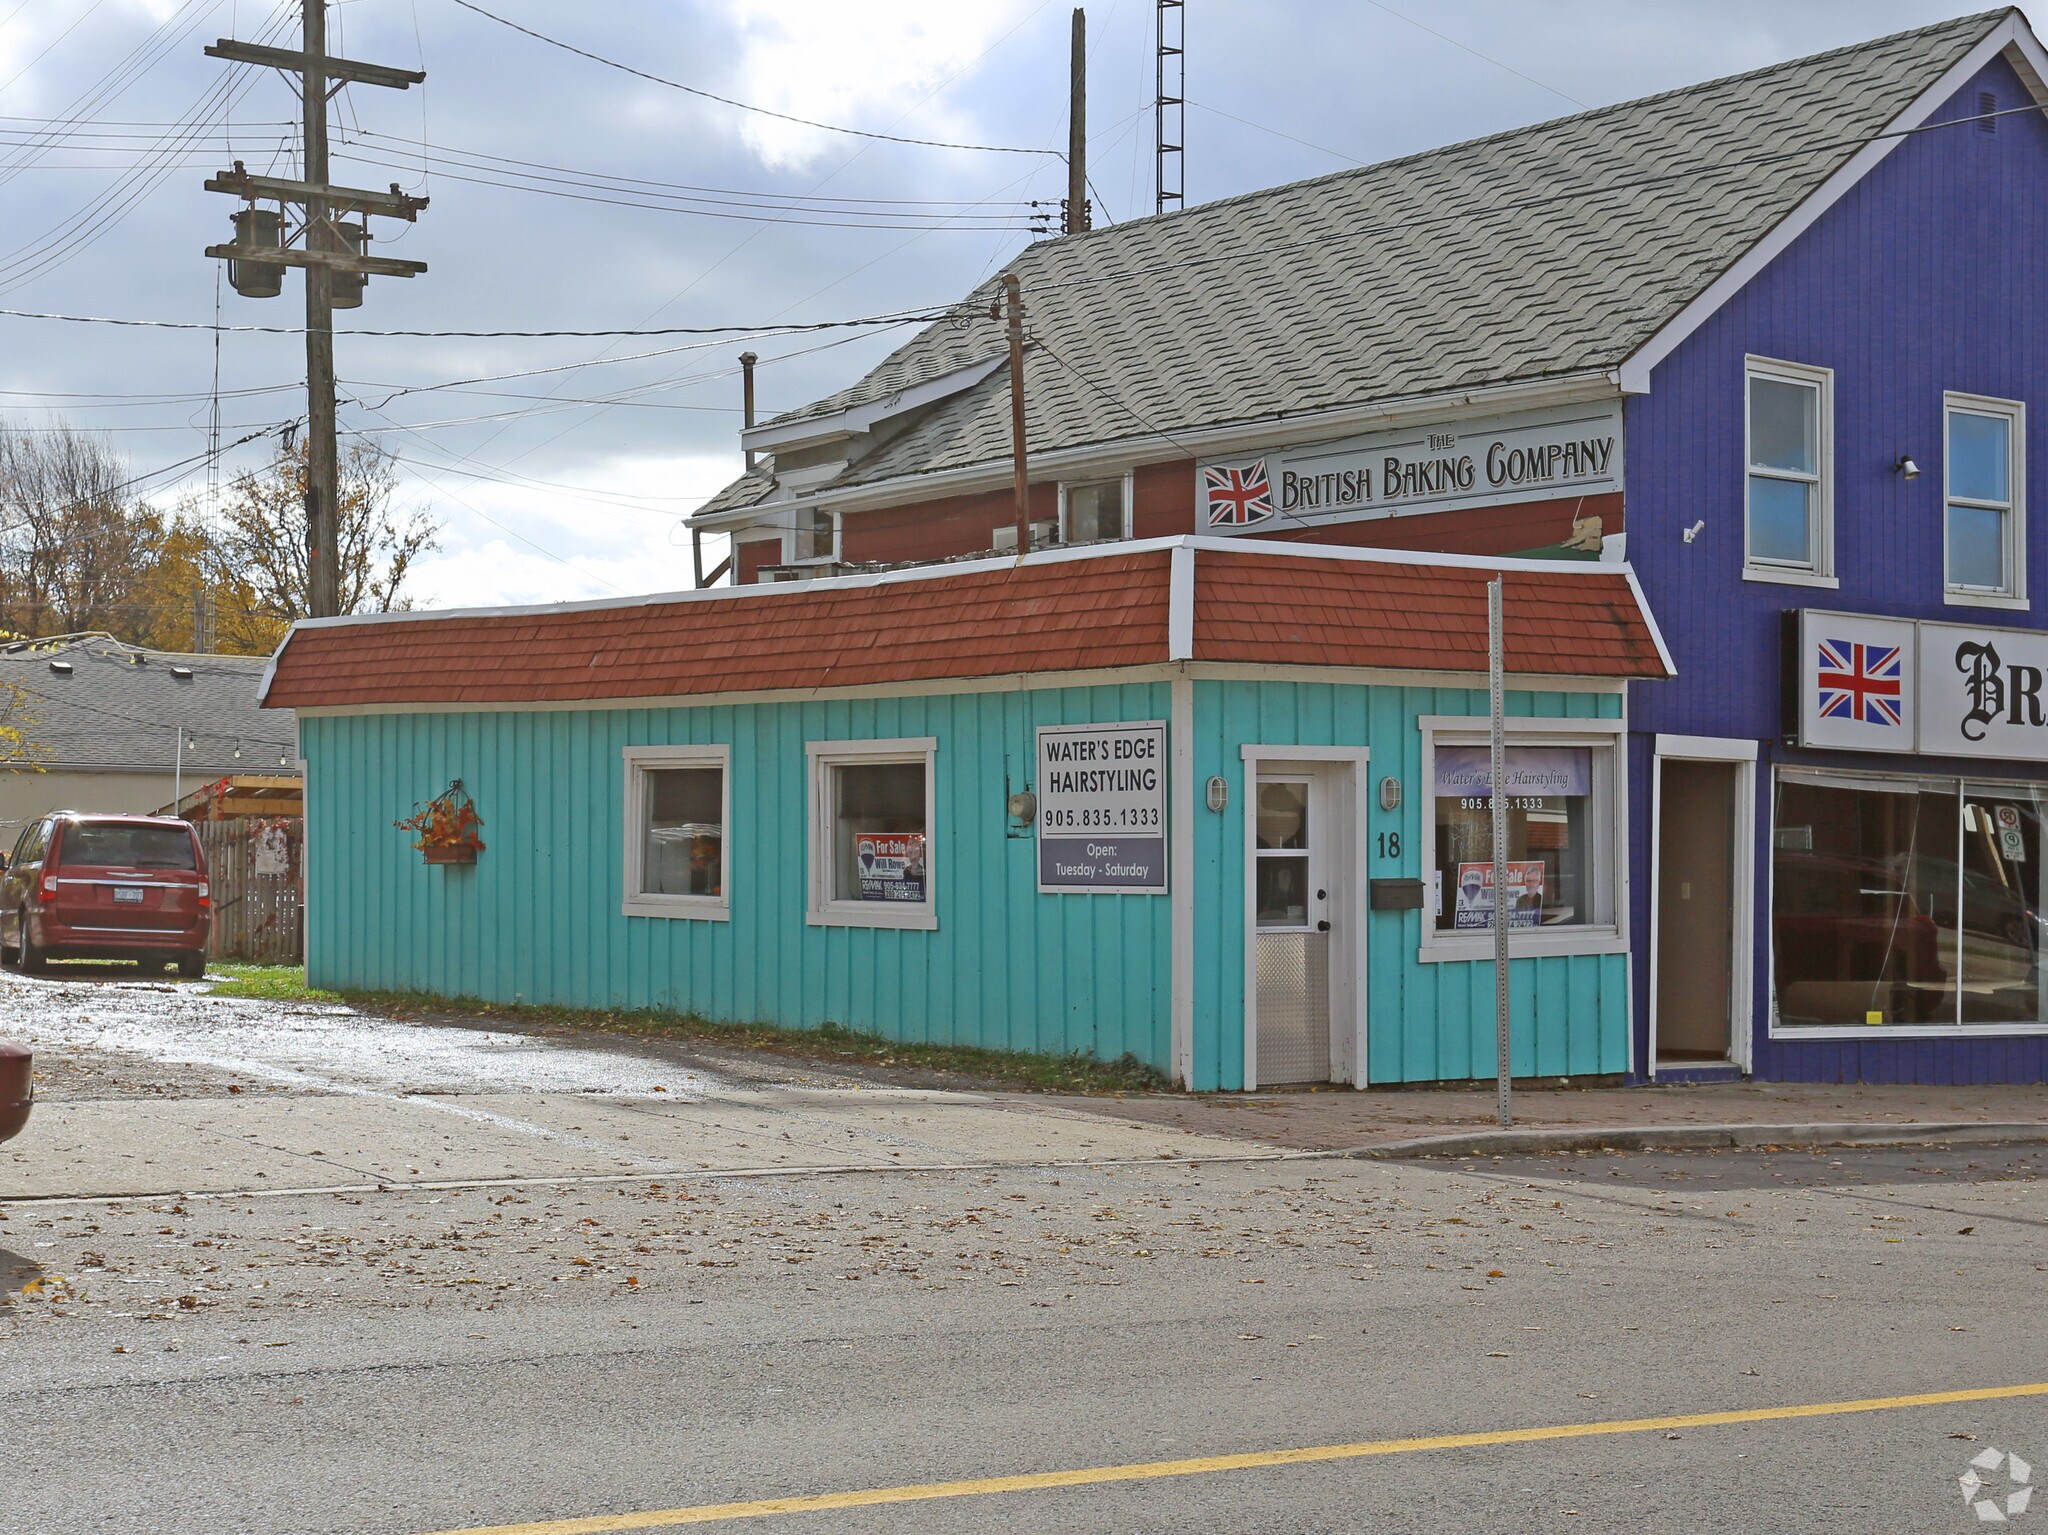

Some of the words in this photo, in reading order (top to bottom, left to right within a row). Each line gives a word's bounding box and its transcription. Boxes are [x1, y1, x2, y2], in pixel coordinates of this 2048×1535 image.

[1427, 433, 1455, 450] THE
[1282, 467, 1373, 510] BRITISH
[1383, 455, 1476, 499] BAKING
[1486, 437, 1615, 486] COMPANY
[1955, 640, 2048, 741] BR
[1046, 740, 1109, 762] WATER'S
[1114, 738, 1155, 760] EDGE
[1050, 768, 1157, 793] HAIRSTYLING
[1441, 770, 1482, 786] Water's
[1485, 771, 1510, 785] Ee
[1512, 769, 1570, 789] Hairstyling
[1461, 797, 1544, 810] 905.85.1333
[1045, 808, 1159, 827] 905.835.1333
[876, 840, 888, 854] For
[889, 840, 906, 854] Sale
[1086, 843, 1118, 859] Open:
[1377, 831, 1401, 859] 18
[875, 858, 888, 869] Will
[888, 858, 905, 870] Rowe
[1055, 862, 1096, 879] Tuesday
[1105, 863, 1149, 880] Saturday
[1485, 869, 1495, 884] Fo
